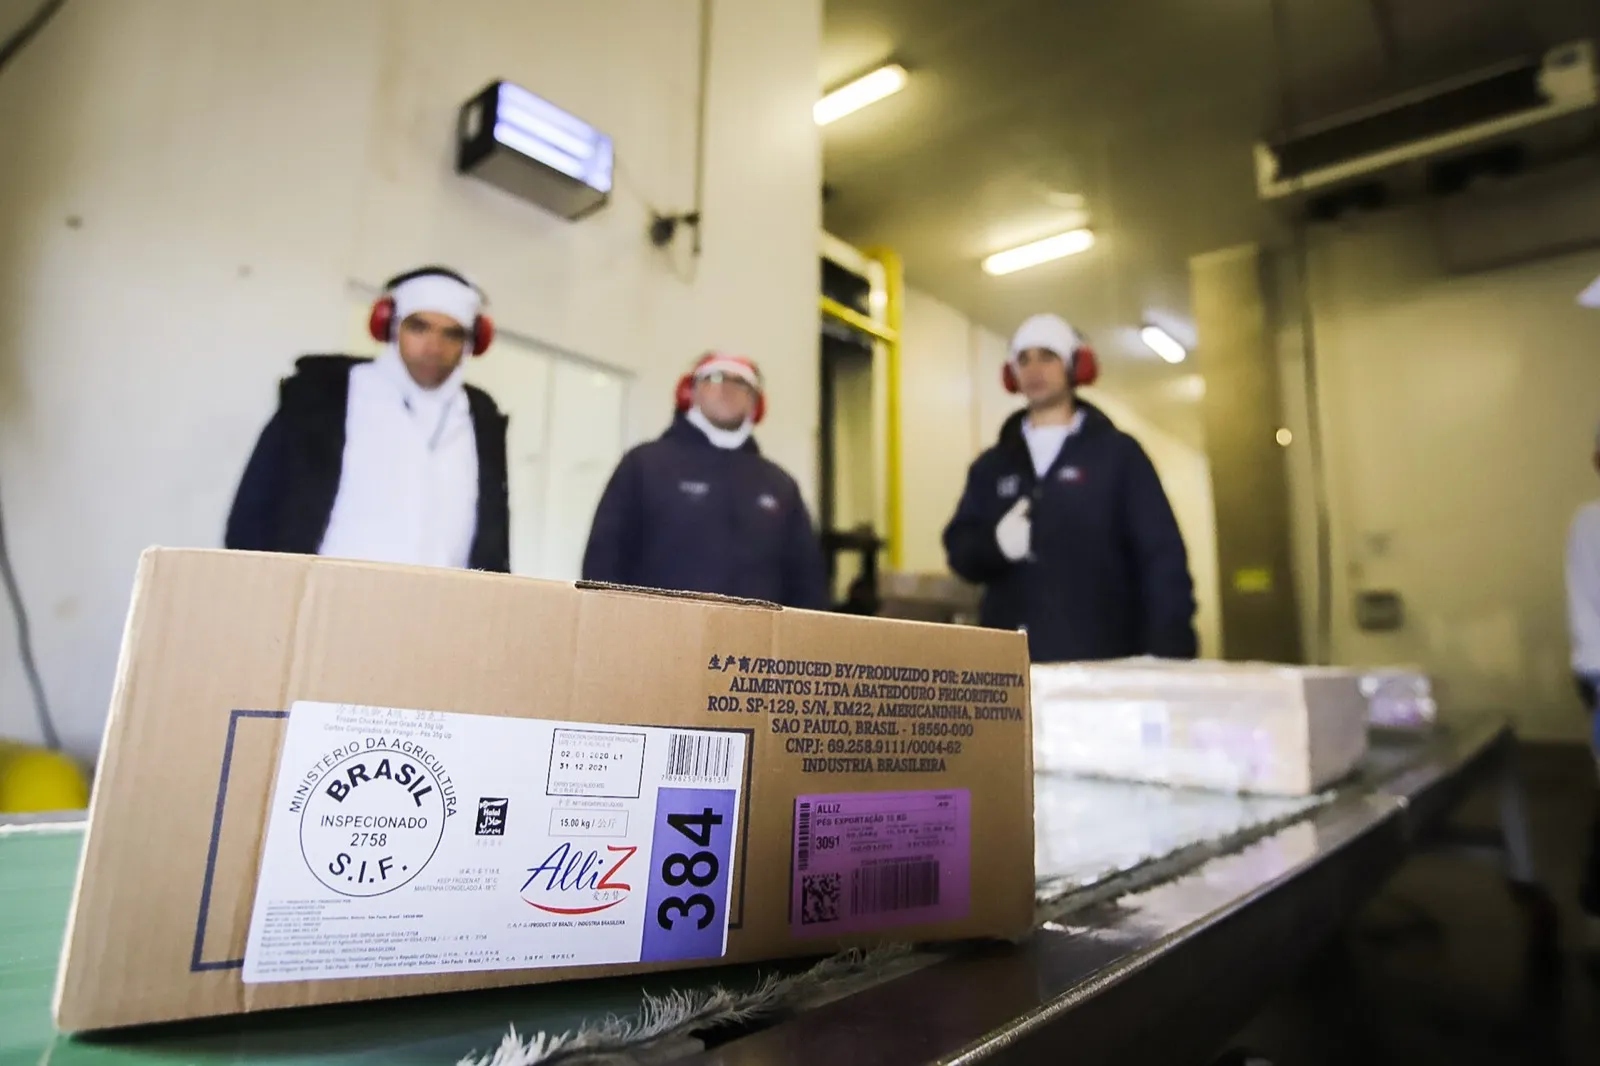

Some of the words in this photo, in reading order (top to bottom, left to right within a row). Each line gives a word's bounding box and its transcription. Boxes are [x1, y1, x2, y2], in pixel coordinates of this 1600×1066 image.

[835, 662, 930, 684] BY/PRODUZIDO
[932, 669, 960, 685] POR:
[961, 671, 1025, 687] ZANCHETTA
[729, 676, 812, 696] ALIMENTOS
[814, 681, 850, 698] LTDA
[852, 682, 935, 701] ABATEDOURO
[707, 695, 743, 712] ROD.
[746, 697, 798, 716] SP-129,
[802, 699, 830, 717] S/N,
[833, 700, 874, 718] KM22,
[876, 703, 972, 721] AMERICANINHA,
[974, 706, 1023, 721] BOITUVA
[771, 718, 800, 735] SAO
[803, 720, 852, 737] PAULO,
[855, 721, 899, 736] BRASIL
[911, 723, 973, 738] 18550-000
[785, 738, 824, 754] CNPJ:
[827, 739, 962, 755] 69.258.9111/0004-62
[802, 757, 873, 773] INDUSTRIA
[877, 757, 946, 773] BRASILEIRA
[289, 740, 360, 813] MINISTÉRIO
[366, 737, 387, 749] DA
[391, 738, 457, 818] AGRICULTURA
[325, 758, 433, 808] BRASIL
[483, 808, 501, 817] Halal
[816, 803, 841, 814] ALLIZ
[320, 815, 428, 829] INSPECIONADO
[560, 818, 579, 828] 15.00
[581, 818, 590, 829] kg
[834, 812, 884, 826] EXPORTAÇÃO
[350, 832, 387, 847] 2758
[815, 835, 840, 850] 3091
[328, 852, 408, 884] S.I.F.
[657, 807, 723, 931] 384
